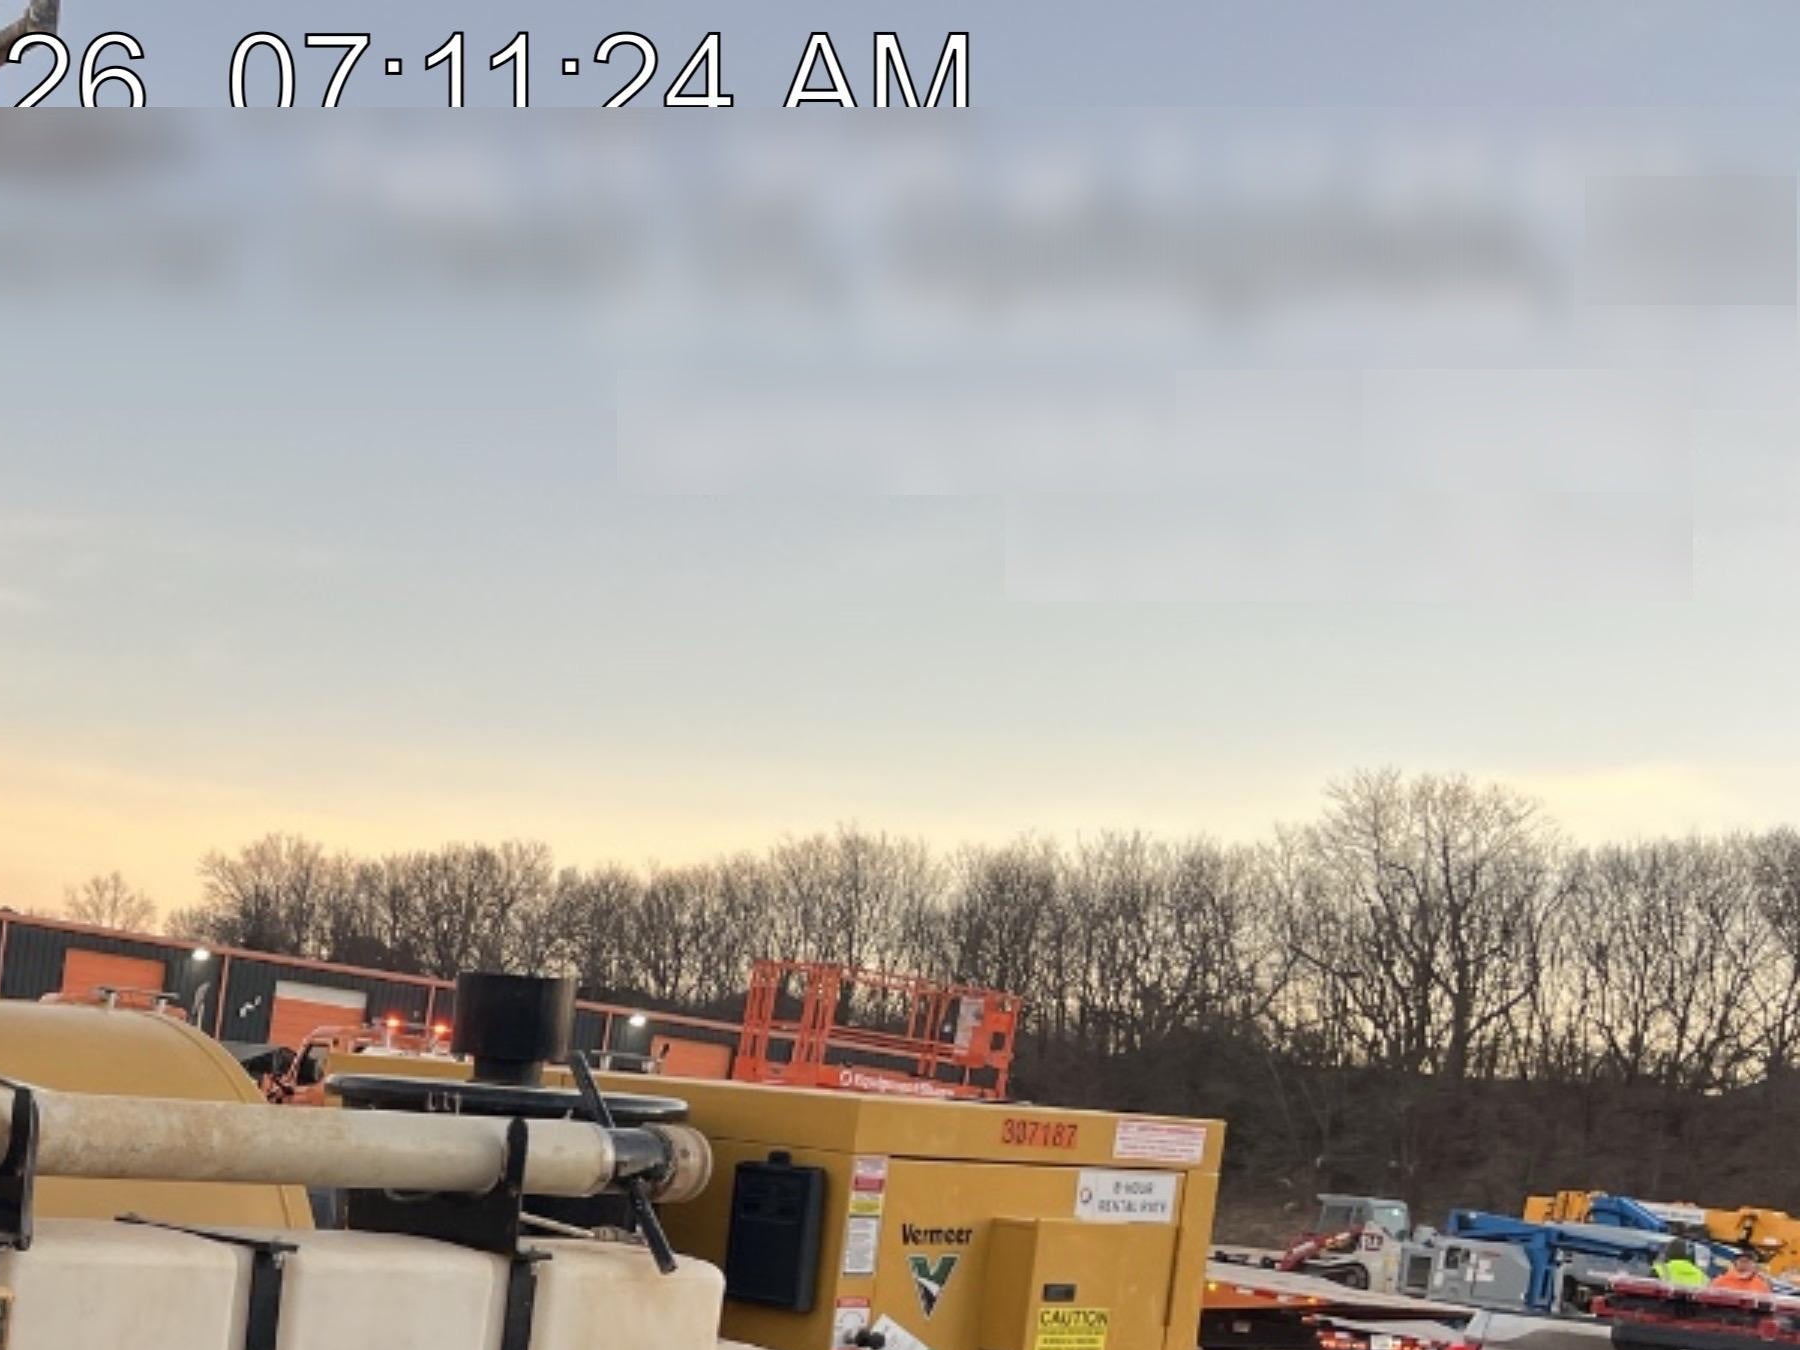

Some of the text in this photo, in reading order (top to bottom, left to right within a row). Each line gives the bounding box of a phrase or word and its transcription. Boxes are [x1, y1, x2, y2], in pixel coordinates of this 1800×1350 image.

[1003, 1119, 1078, 1148] 307187
[902, 1223, 973, 1245] Vermeer
[1041, 1309, 1108, 1328] CAUTION
